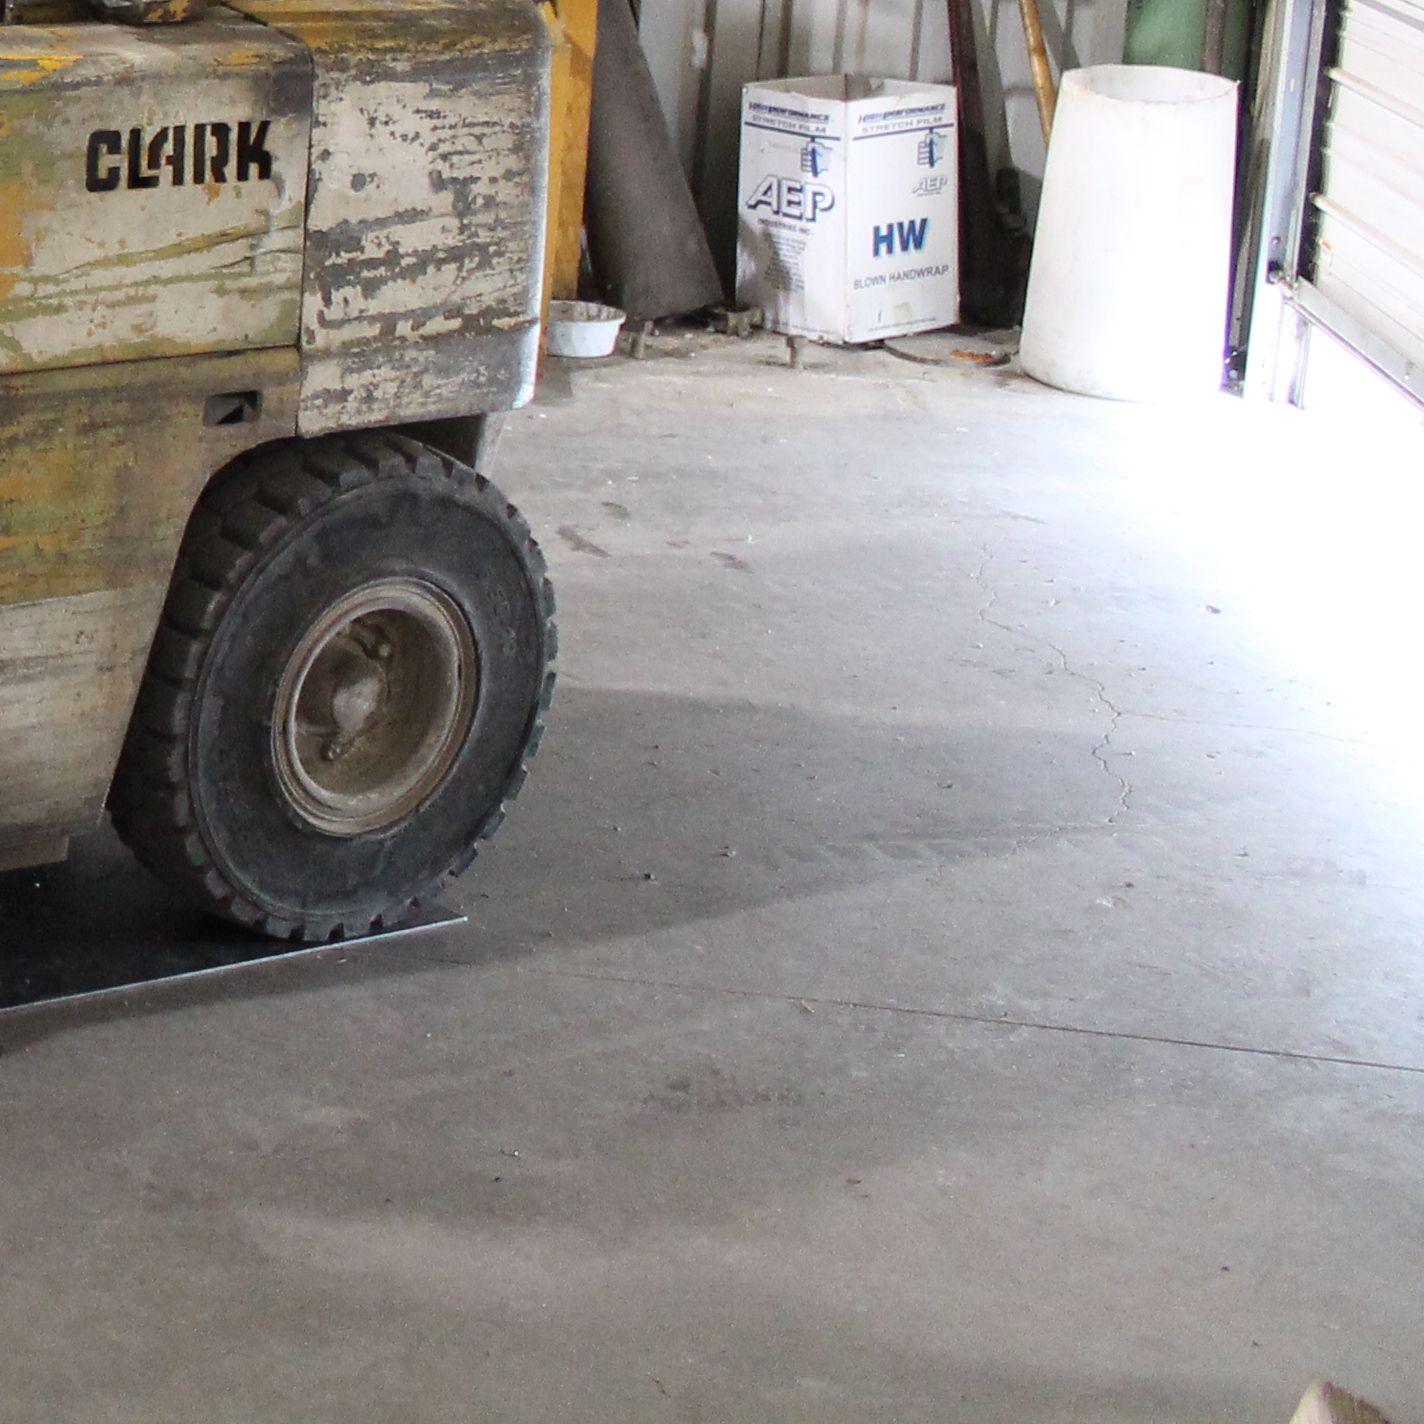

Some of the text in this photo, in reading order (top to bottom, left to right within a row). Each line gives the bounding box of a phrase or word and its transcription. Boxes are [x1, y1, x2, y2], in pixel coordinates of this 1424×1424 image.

[752, 115, 797, 130] STRETCH
[862, 116, 943, 133] STRETCH FILM
[85, 120, 273, 192] CLARK
[912, 176, 948, 193] AEP
[746, 174, 835, 223] AEP
[873, 217, 928, 257] HW
[853, 264, 949, 290] BLOWN HANDWRAP
